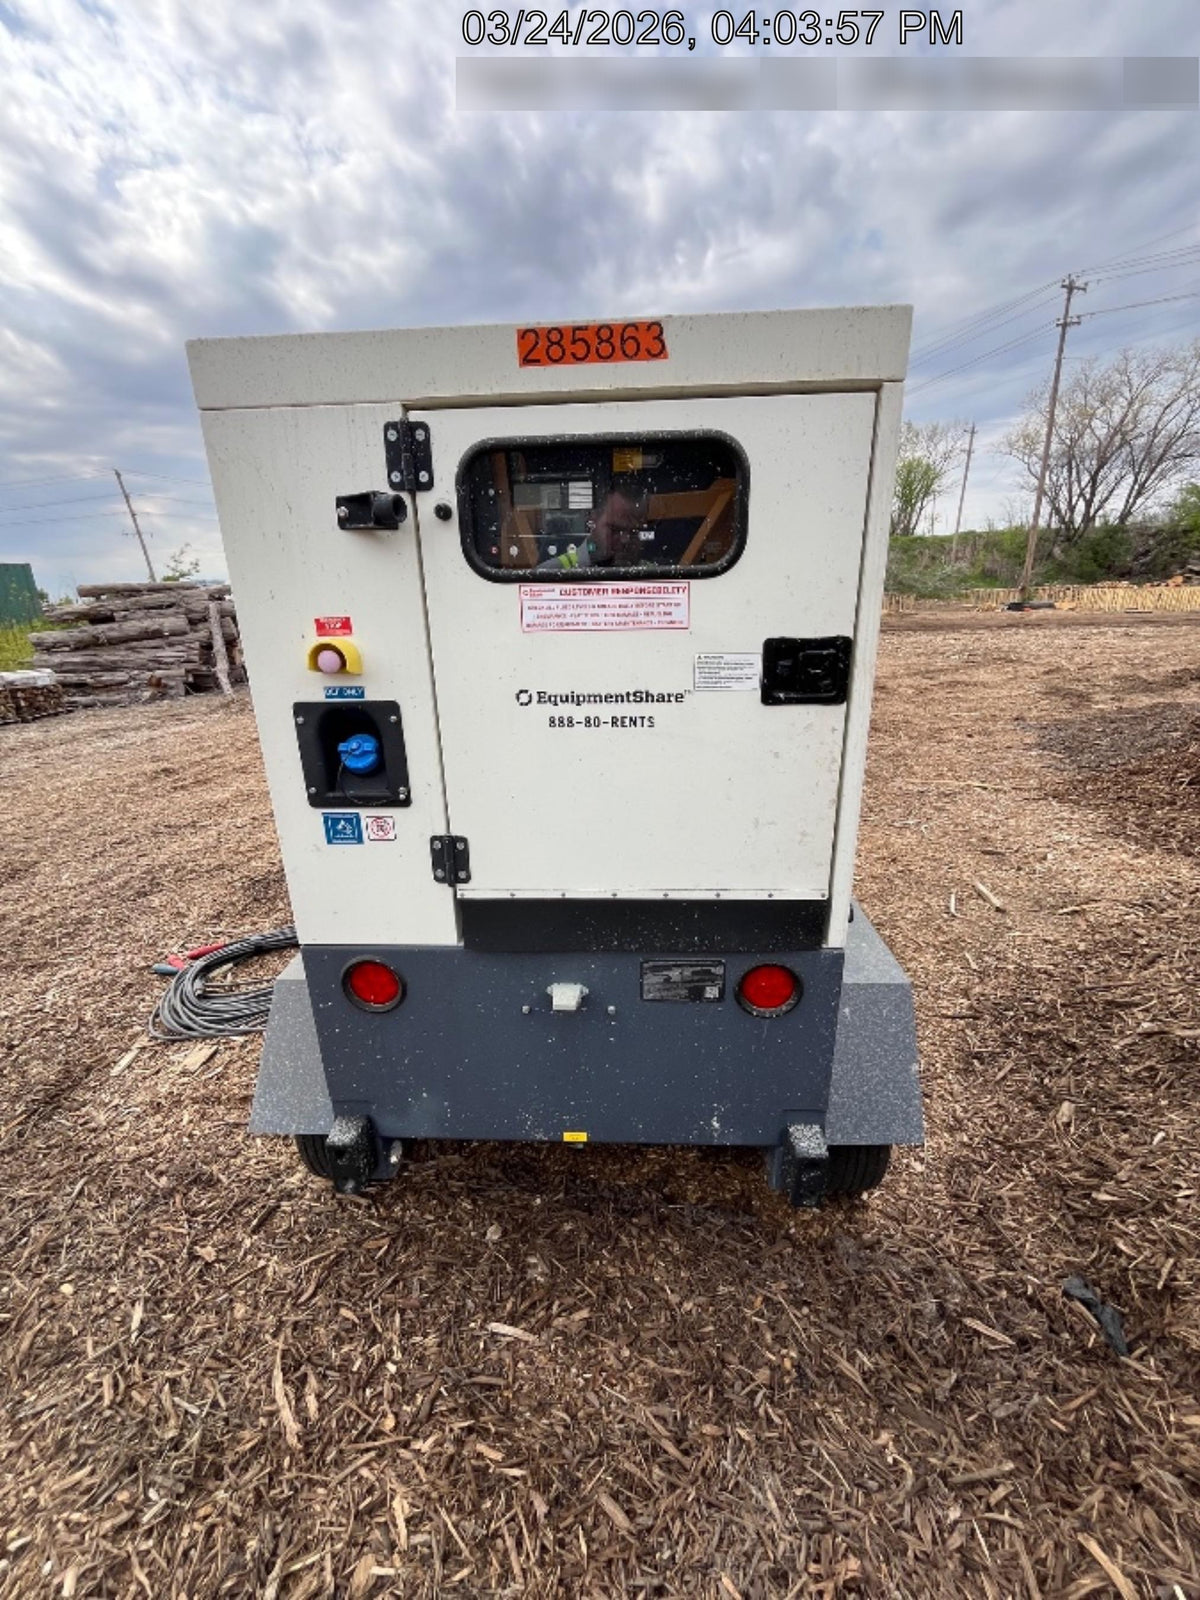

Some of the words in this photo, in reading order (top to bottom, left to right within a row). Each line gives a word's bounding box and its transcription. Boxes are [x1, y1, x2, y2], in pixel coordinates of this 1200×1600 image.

[520, 321, 667, 364] 285863
[536, 690, 685, 706] EquipmentShare
[549, 715, 656, 728] 888-80-RENTS
